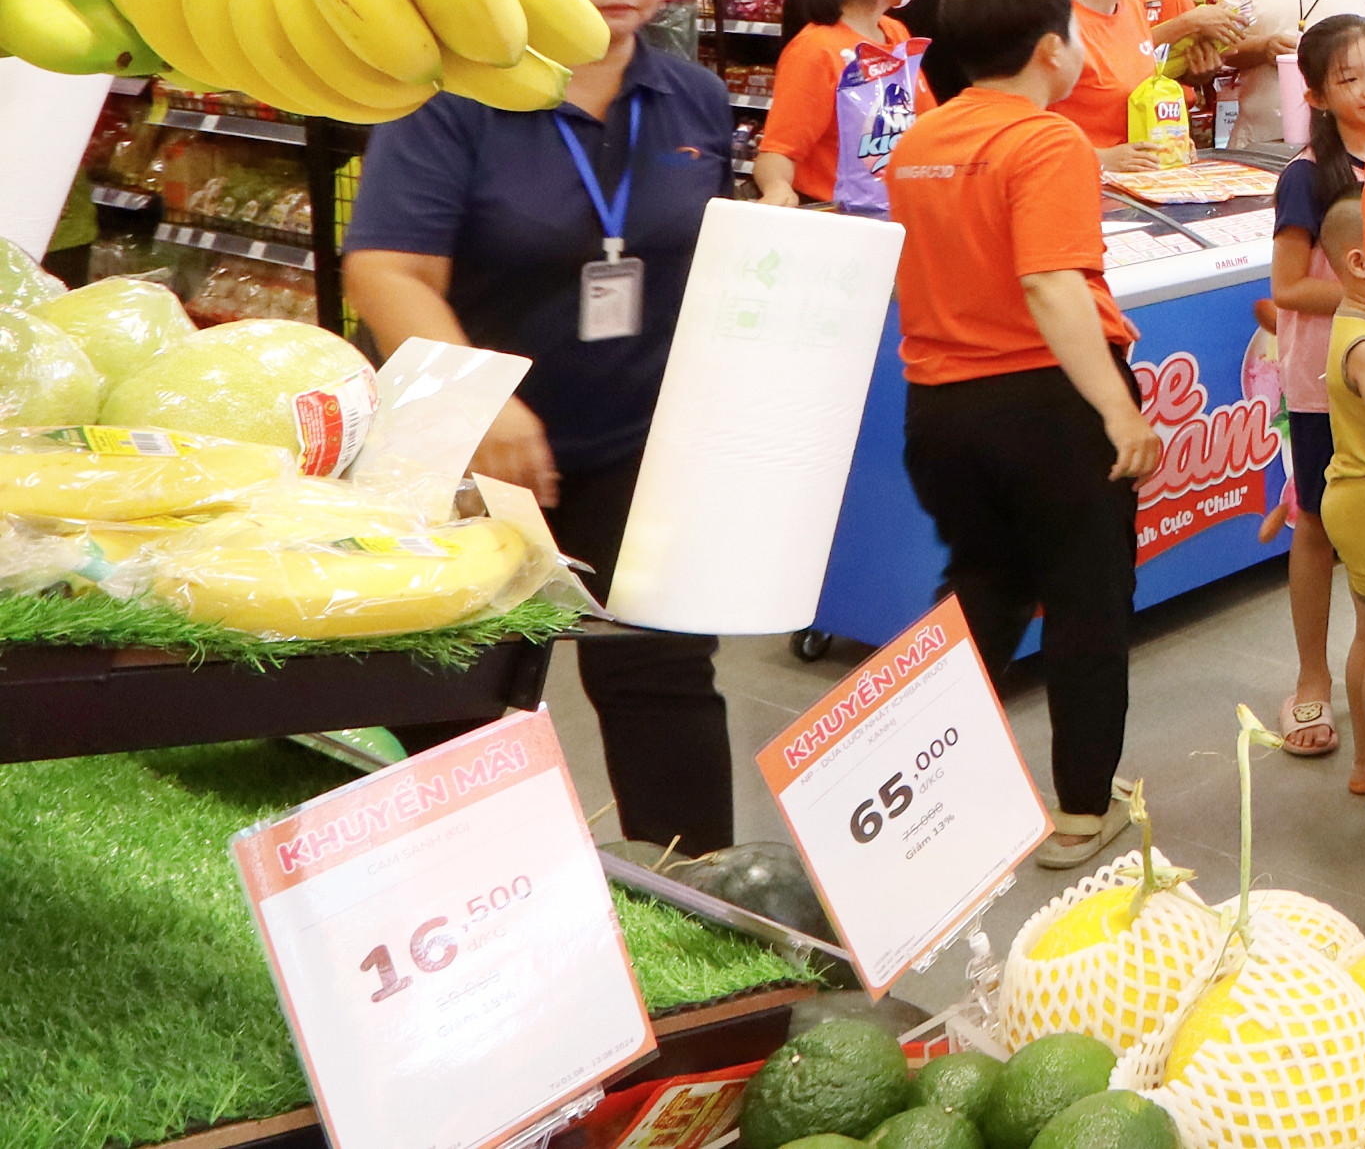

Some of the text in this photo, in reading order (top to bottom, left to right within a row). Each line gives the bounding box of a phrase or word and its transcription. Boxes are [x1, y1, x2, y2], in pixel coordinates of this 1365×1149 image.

[1215, 255, 1249, 269] DARLING
[1160, 509, 1193, 535] Cực
[784, 624, 947, 770] KHUYẾN MÃI
[277, 739, 529, 876] KHUYẾN MÃI
[850, 727, 960, 845] 65,000
[905, 813, 955, 861] Giảm 13%
